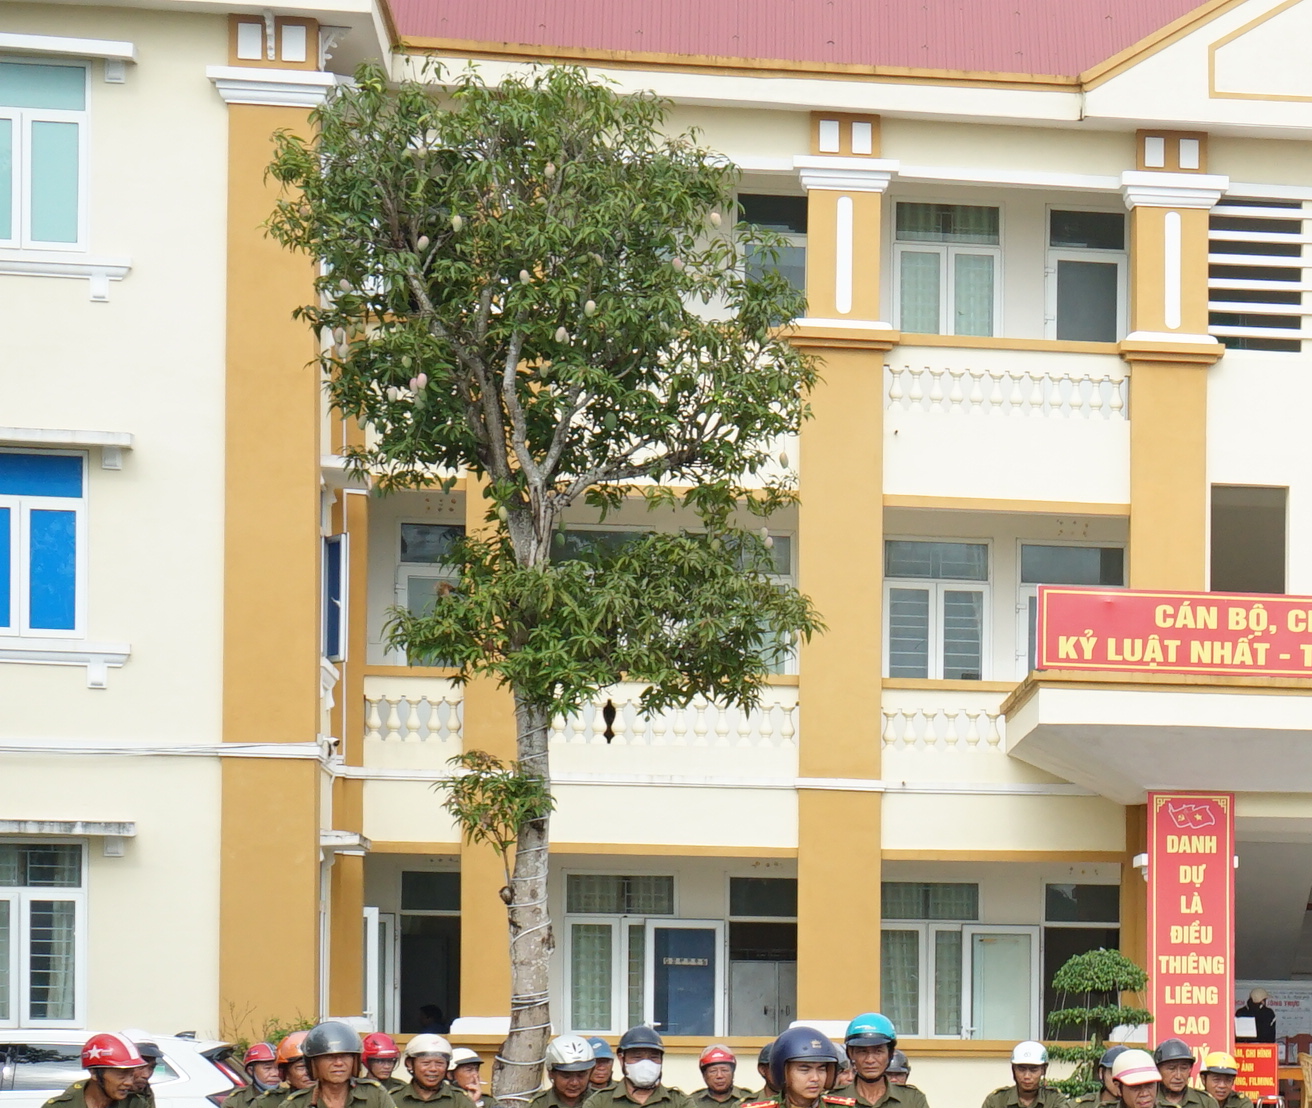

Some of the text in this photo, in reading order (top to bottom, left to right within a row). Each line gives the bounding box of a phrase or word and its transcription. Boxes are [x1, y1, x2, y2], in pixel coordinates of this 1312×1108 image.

[1155, 601, 1218, 629] CÁN
[1228, 604, 1277, 636] BỘ,
[1058, 629, 1097, 660] KỶ
[1107, 635, 1181, 667] LUẬT
[1190, 634, 1270, 665] NHẤT
[1166, 835, 1217, 854] DANH
[1179, 864, 1206, 887] DỰ
[1180, 892, 1203, 914] LÀ
[1170, 920, 1213, 944] ĐIỀU
[1158, 952, 1225, 975] THIÊNG
[1165, 982, 1218, 1005] LIÊNG
[1173, 1016, 1210, 1035] CAO
